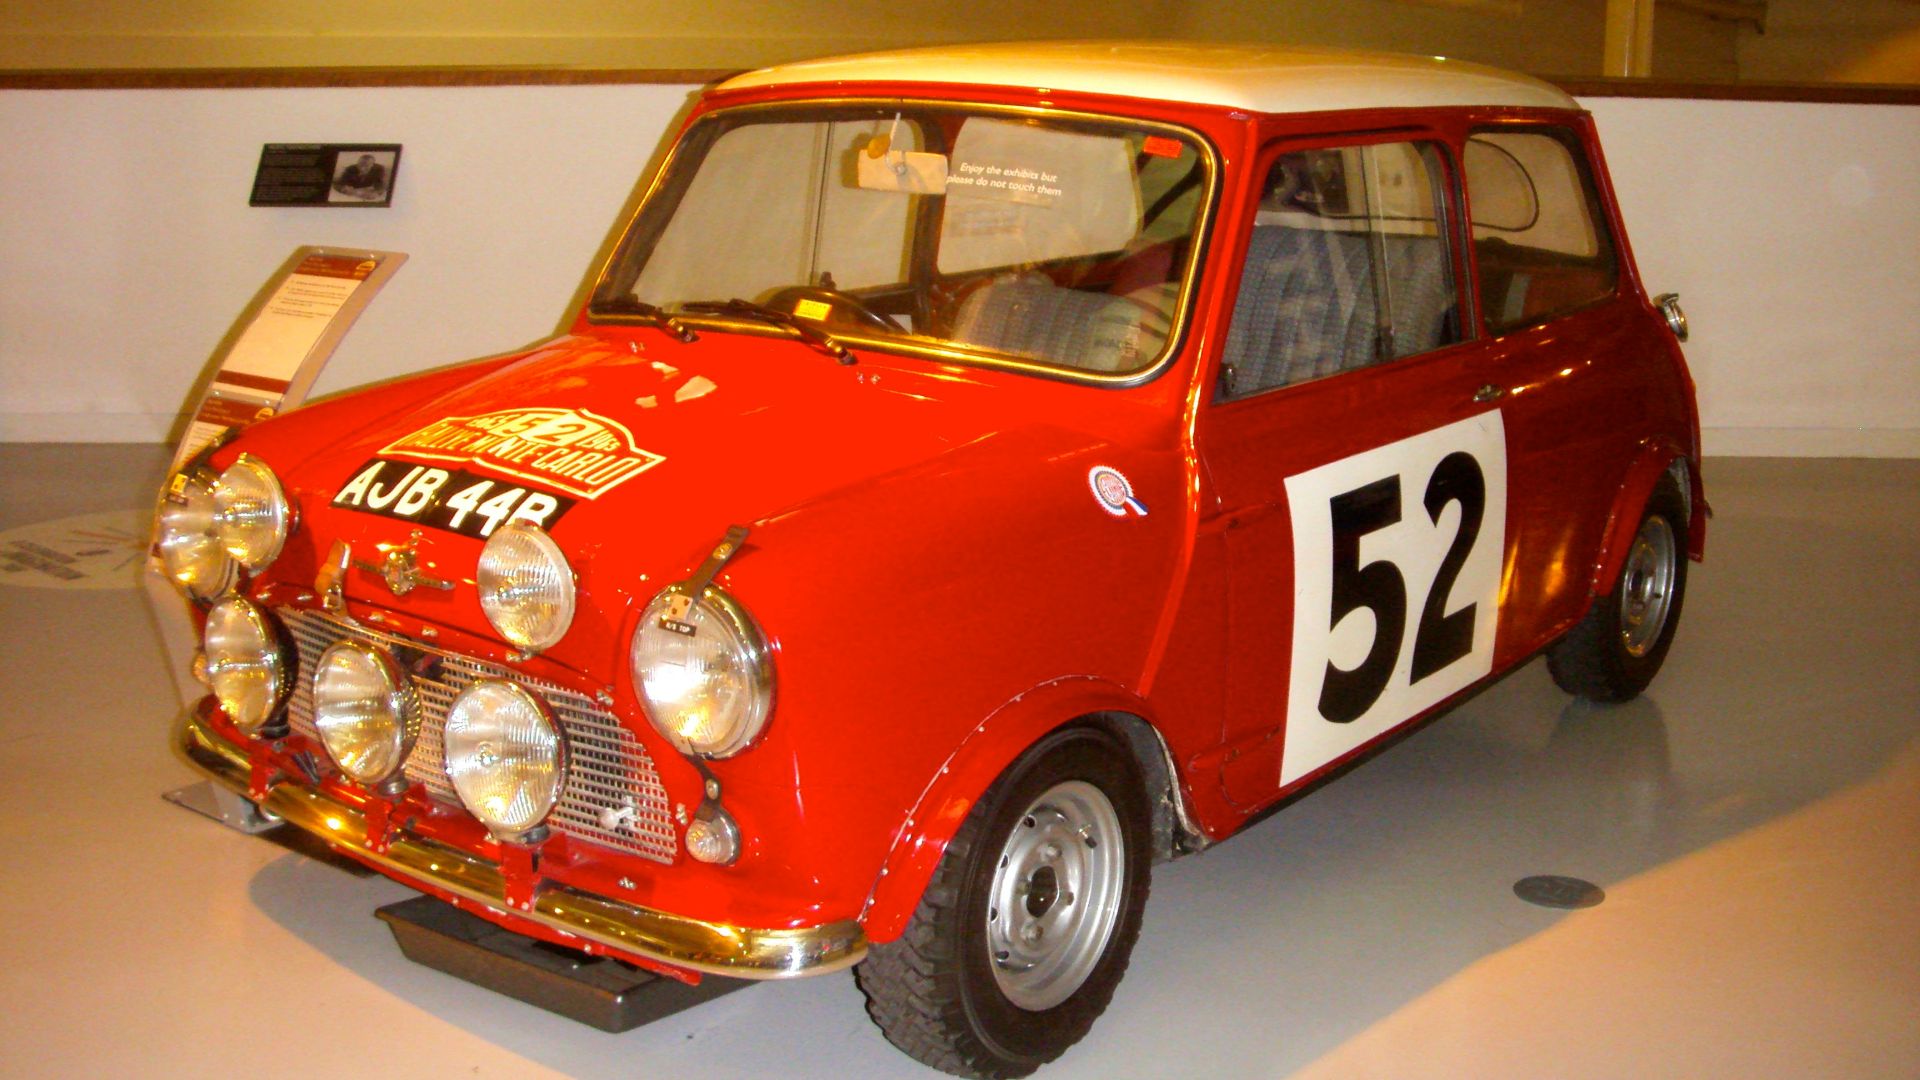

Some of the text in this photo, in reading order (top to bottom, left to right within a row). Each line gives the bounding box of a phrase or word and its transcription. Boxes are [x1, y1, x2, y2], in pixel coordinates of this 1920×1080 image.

[945, 174, 1062, 196] please do not touch them
[960, 162, 1057, 183] Enjoy the exhibits but
[500, 415, 588, 443] 52
[333, 461, 450, 516] AJB
[1317, 450, 1486, 724] 52
